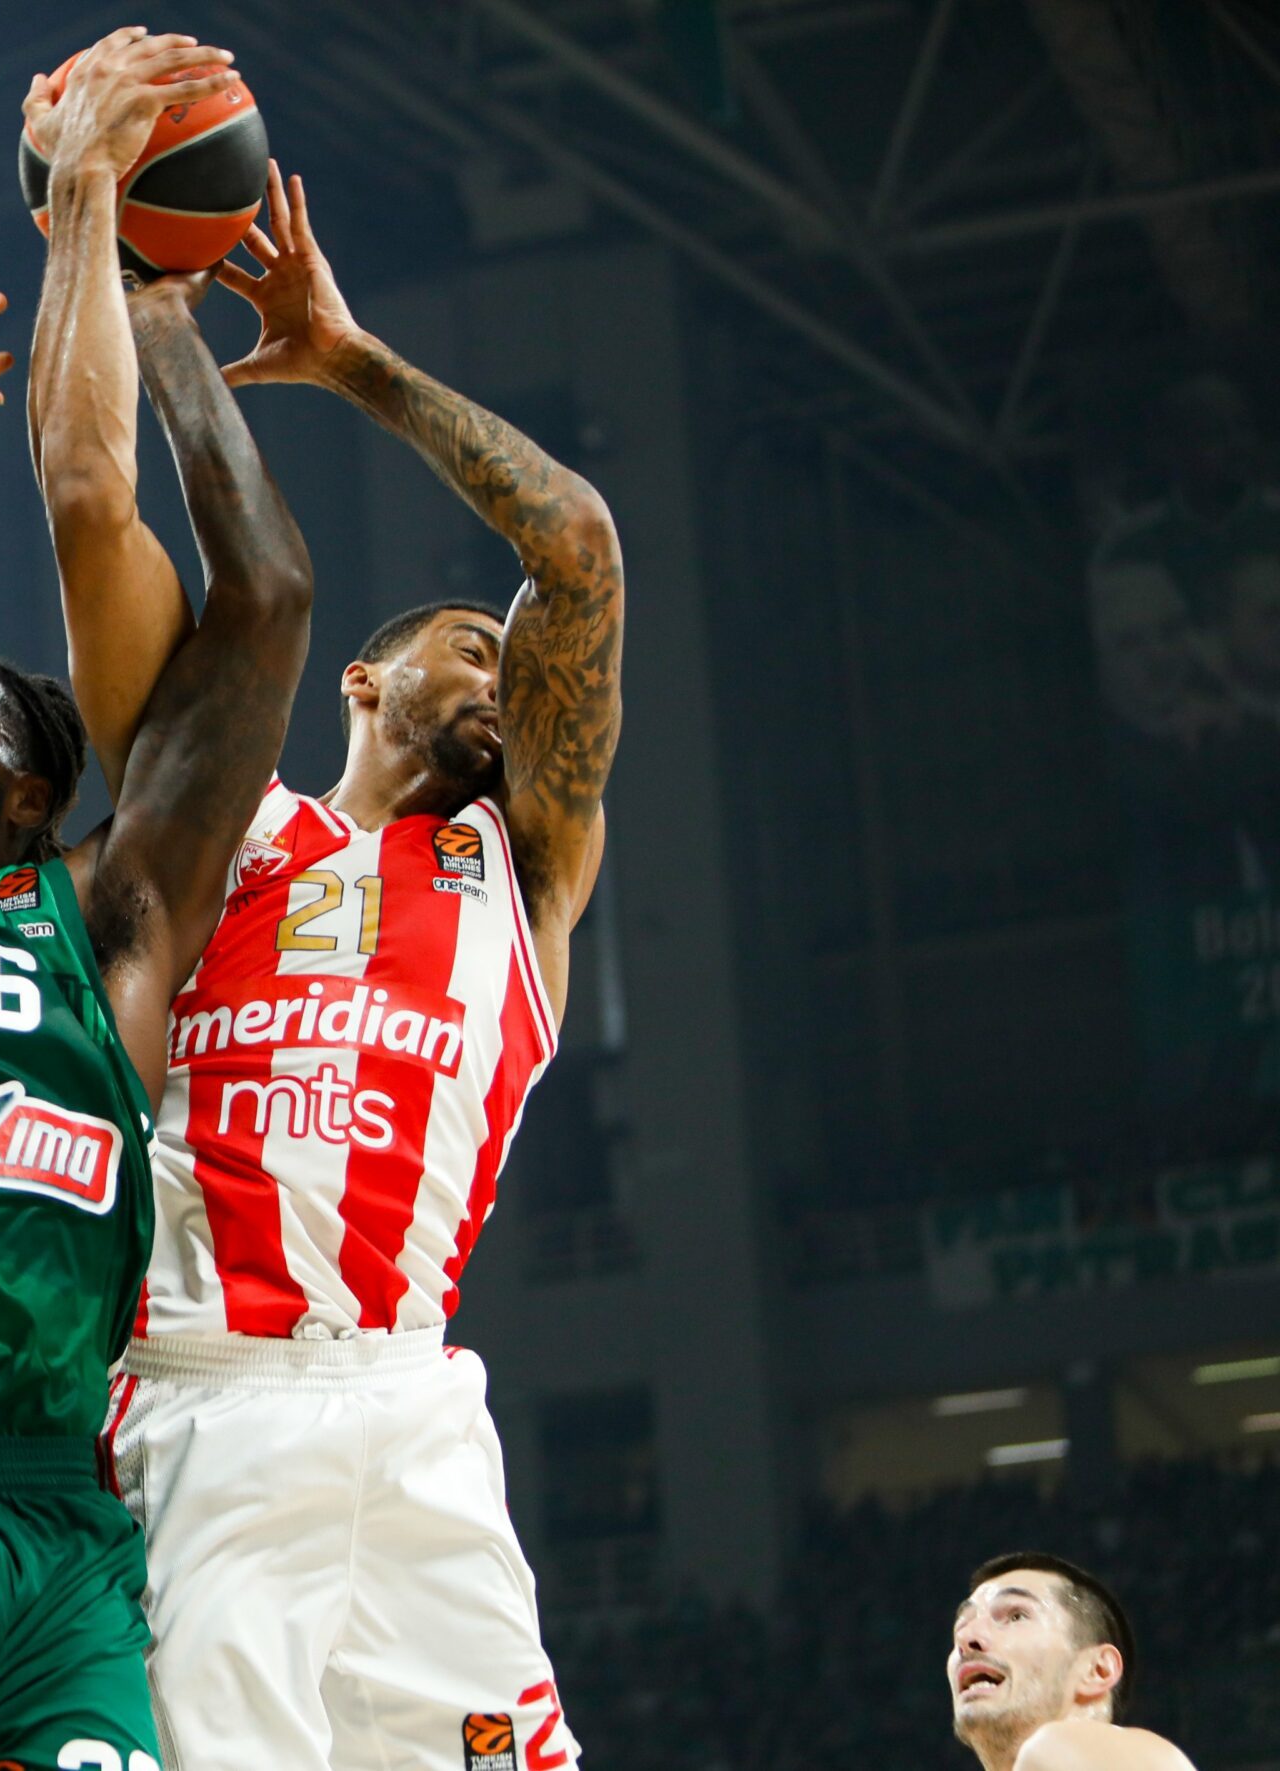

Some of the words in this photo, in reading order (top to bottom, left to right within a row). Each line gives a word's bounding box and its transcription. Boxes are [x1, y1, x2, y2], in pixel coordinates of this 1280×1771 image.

[442, 855, 481, 867] TURKISH
[275, 870, 383, 956] 21
[176, 982, 463, 1068] meridian
[218, 1065, 396, 1149] mts
